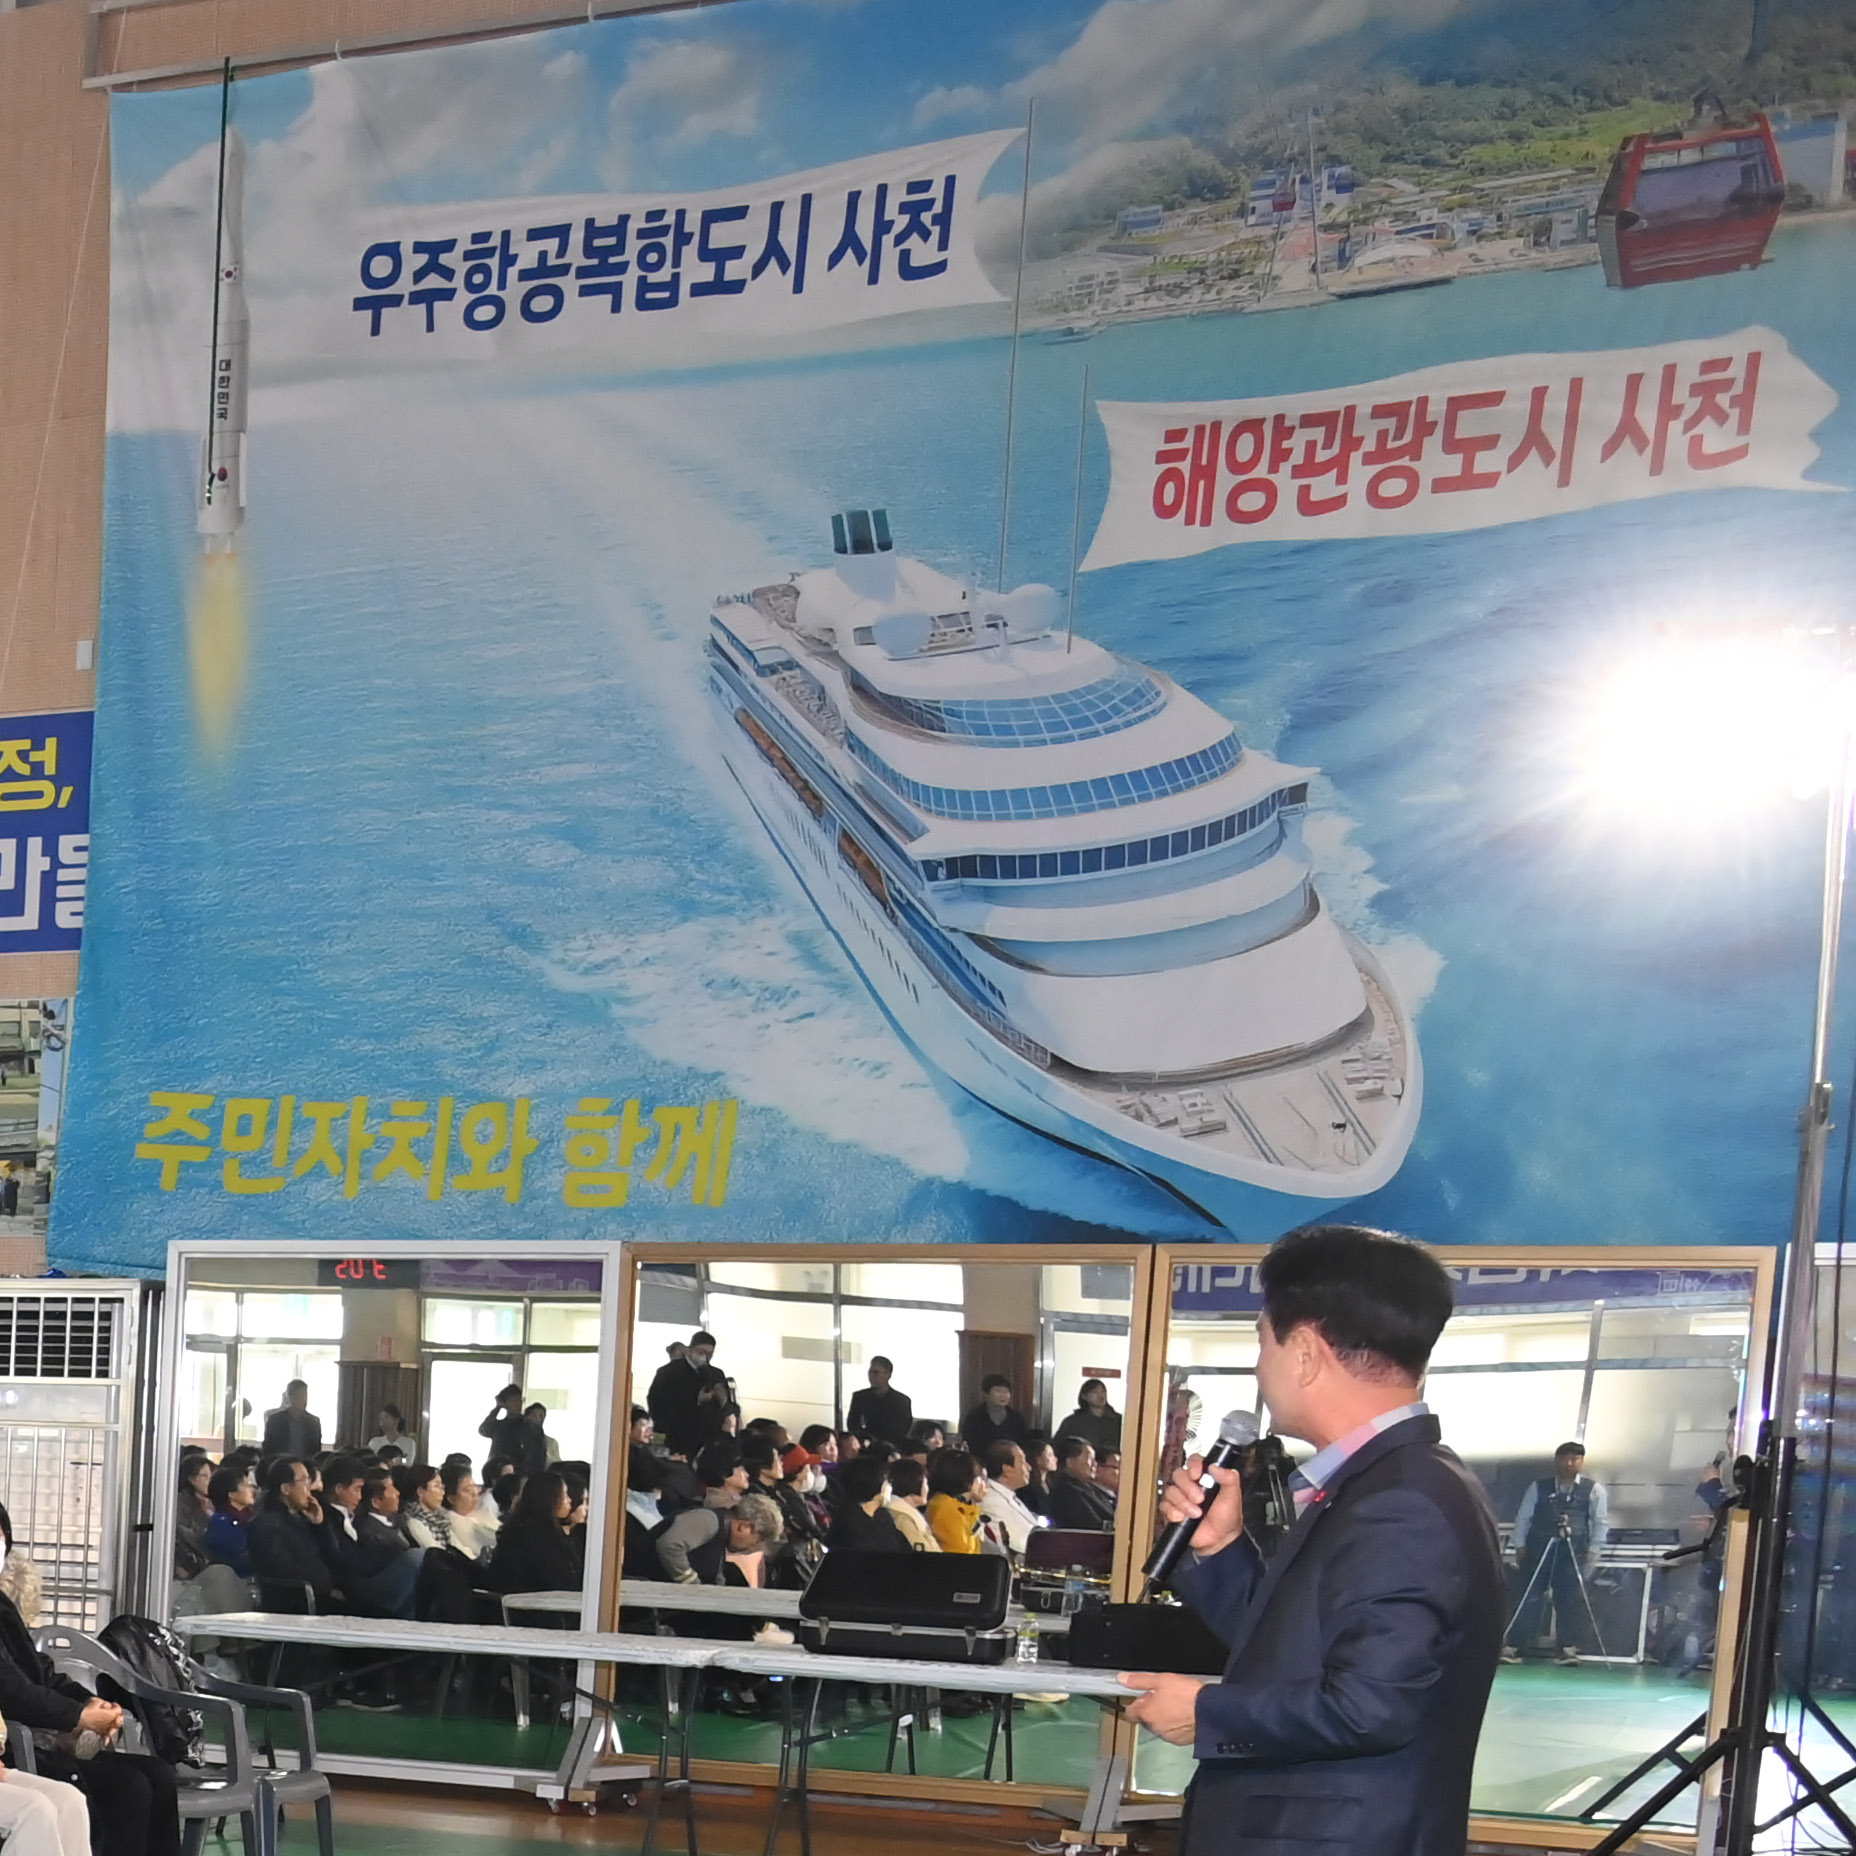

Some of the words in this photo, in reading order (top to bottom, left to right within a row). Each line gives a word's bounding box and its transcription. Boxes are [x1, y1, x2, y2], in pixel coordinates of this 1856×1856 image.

[353, 193, 812, 336] 우주항공복합도시
[829, 174, 956, 285] 사천
[215, 358, 232, 420] 대한민국
[1152, 376, 1585, 527] 해양관광도시
[1599, 350, 1763, 478] 사천
[136, 1091, 539, 1204] 주민자치와
[564, 1097, 738, 1208] 함께
